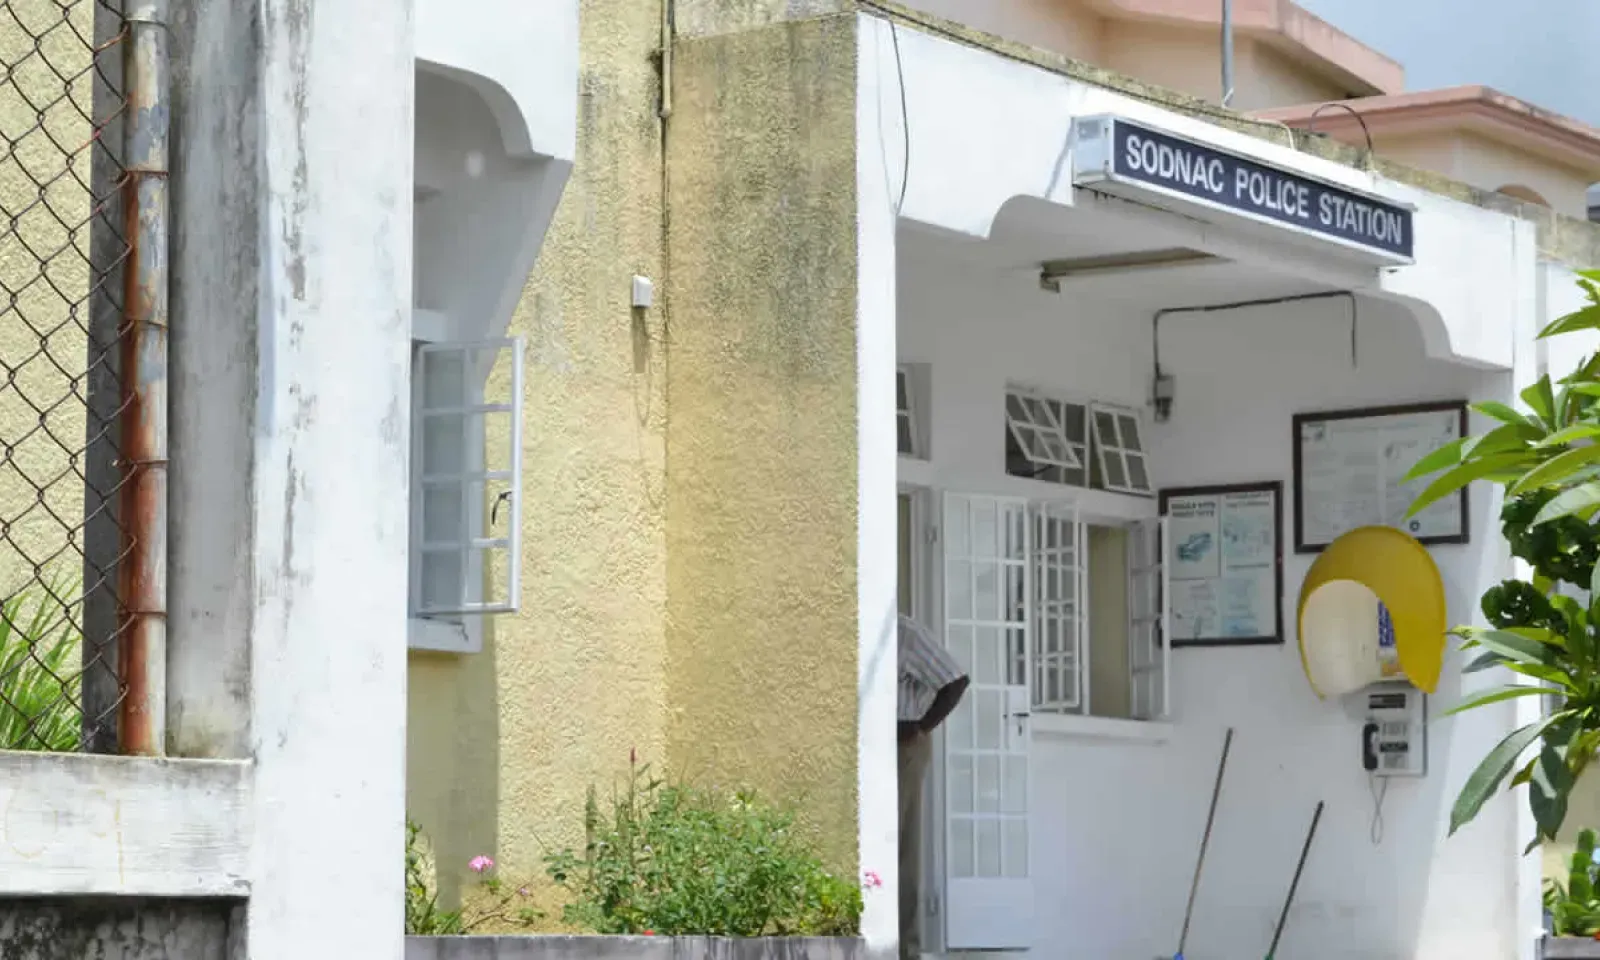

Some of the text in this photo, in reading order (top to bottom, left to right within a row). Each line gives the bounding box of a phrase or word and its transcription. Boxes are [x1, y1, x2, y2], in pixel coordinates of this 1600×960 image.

[1126, 134, 1402, 244] SODNAC POLICE STATION
